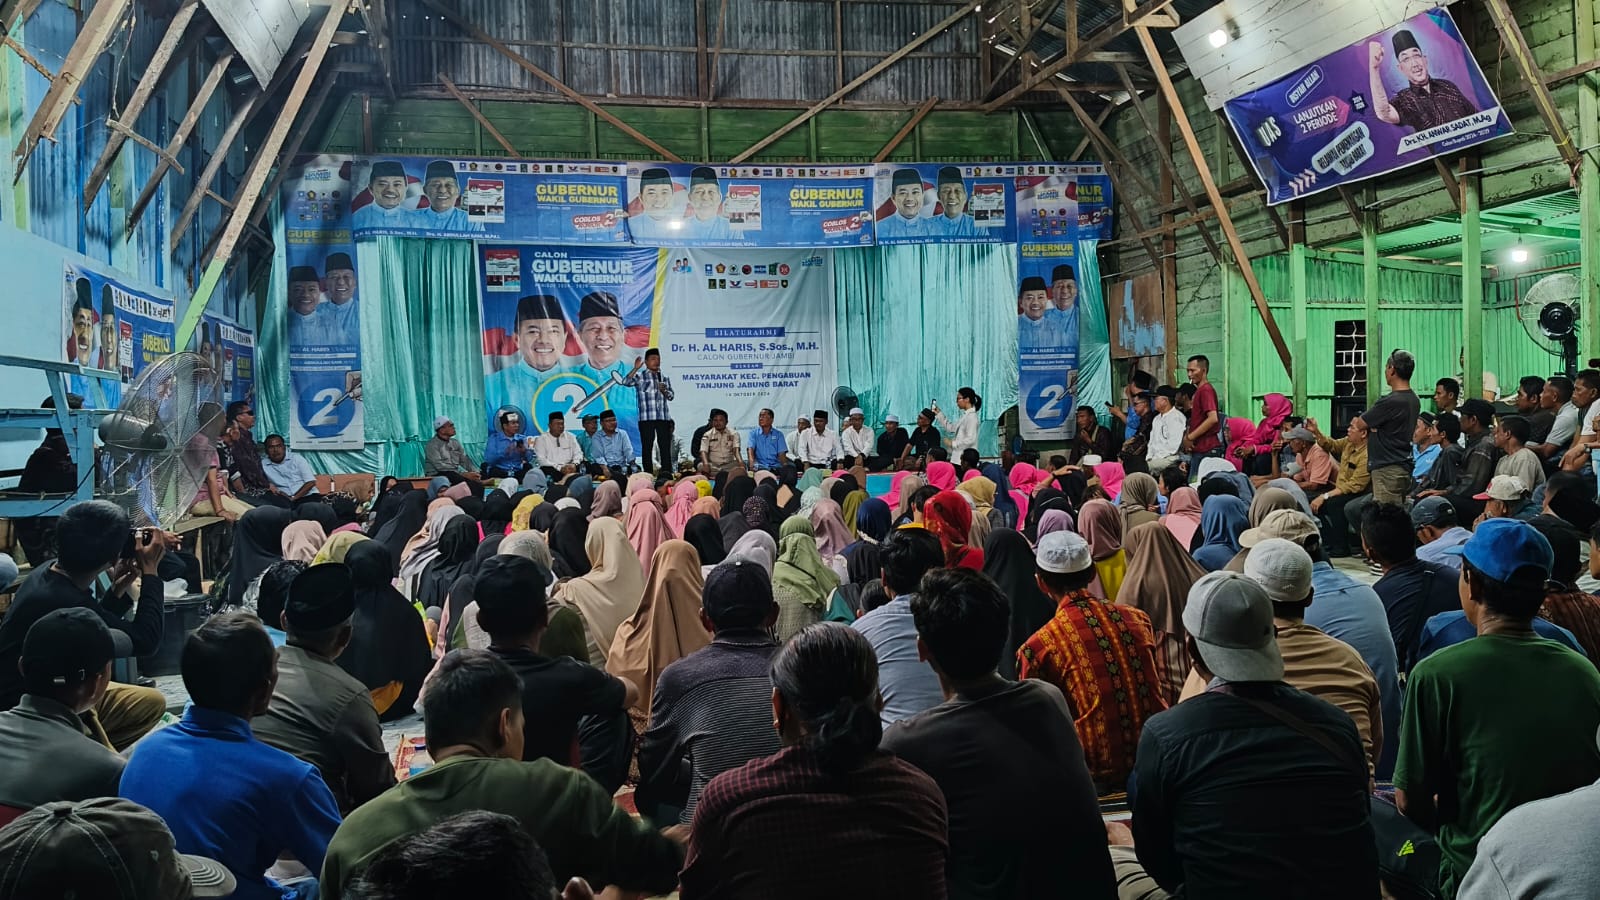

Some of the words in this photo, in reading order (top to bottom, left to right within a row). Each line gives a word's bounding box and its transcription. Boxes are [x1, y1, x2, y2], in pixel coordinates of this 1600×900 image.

[1293, 100, 1338, 124] LANJUTKAN
[1300, 125, 1308, 134] 2
[1307, 112, 1339, 132] PERIODE
[1428, 127, 1451, 138] ANWAR
[1450, 119, 1475, 132] SADAT,
[1474, 114, 1492, 125] M.Ag
[1258, 116, 1282, 147] UAS
[536, 184, 618, 196] GUBERNUR
[790, 188, 865, 200] GUBERNUR
[537, 195, 567, 203] WAKIL
[569, 196, 619, 204] GUBERNUR
[791, 200, 818, 208] WAKIL
[819, 200, 865, 208] GUBERNUR
[603, 213, 614, 226] 2
[850, 216, 861, 228] 2
[1092, 211, 1101, 223] 2
[1022, 244, 1073, 252] GUBERNUR
[534, 251, 568, 259] CALON
[532, 259, 633, 274] GUBERNUR
[533, 273, 571, 283] WAKIL
[572, 274, 634, 284] GUBERNUR
[714, 328, 777, 337] SILATURAHMI
[671, 344, 685, 352] Dr.
[689, 344, 700, 352] H.
[703, 344, 717, 352] AL
[720, 343, 757, 353] HARIS,
[759, 342, 794, 353] S.Sos.,
[796, 341, 819, 351] M.H.
[697, 353, 725, 361] CALON
[682, 373, 738, 381] MASYARAKAT
[772, 380, 799, 388] BARAT
[307, 387, 343, 426] 2
[550, 383, 590, 431] 2
[1034, 384, 1064, 419] 2
